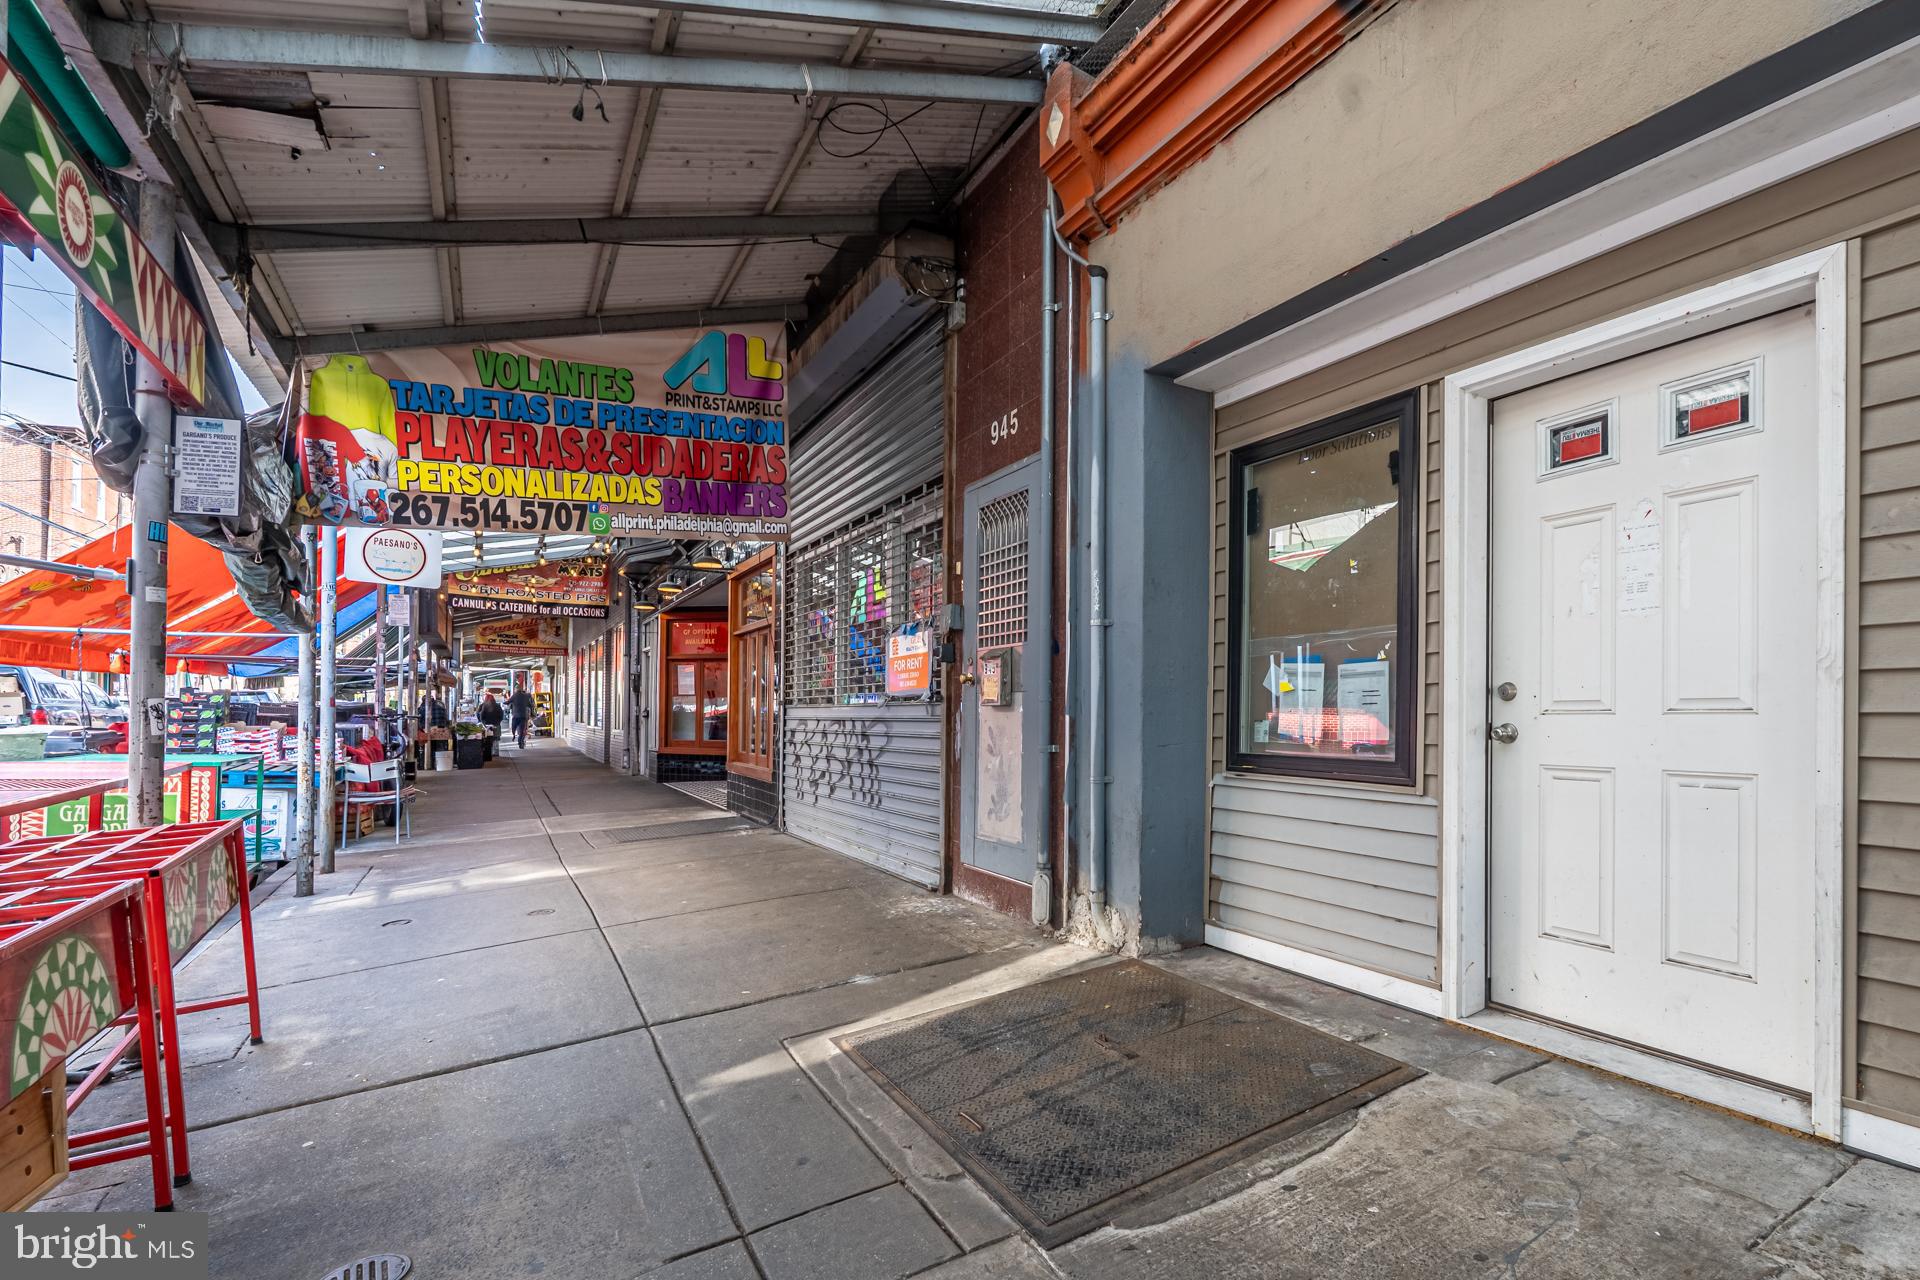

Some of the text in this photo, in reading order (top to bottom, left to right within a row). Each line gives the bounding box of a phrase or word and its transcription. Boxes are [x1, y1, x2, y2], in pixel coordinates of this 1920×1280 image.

[473, 348, 635, 404] VOLANTES
[389, 379, 784, 446] TARJETAS DE PRESENTACION
[665, 391, 783, 418] PRINT&STAMPS LLC
[212, 433, 237, 441] PRODUCE
[990, 407, 1019, 446] 945
[1330, 424, 1393, 455] Solutions
[395, 411, 787, 485] PLAYERAS&SUDADERAS
[396, 459, 788, 518] PERSONALIZADAS BANNERS
[388, 492, 589, 532] 267.514.5707
[609, 512, 789, 537] allprint.philadelphia@gmail.com
[373, 536, 419, 550] PAESANO'S
[557, 564, 604, 578] MATS
[505, 587, 572, 601] ROASTED
[575, 592, 607, 604] PIGS
[499, 601, 538, 614] CATERING
[539, 605, 552, 615] for
[552, 606, 561, 616] all
[562, 606, 606, 618] OCCASIONS
[498, 638, 529, 646] POULTRY
[893, 656, 924, 673] FOR RENT
